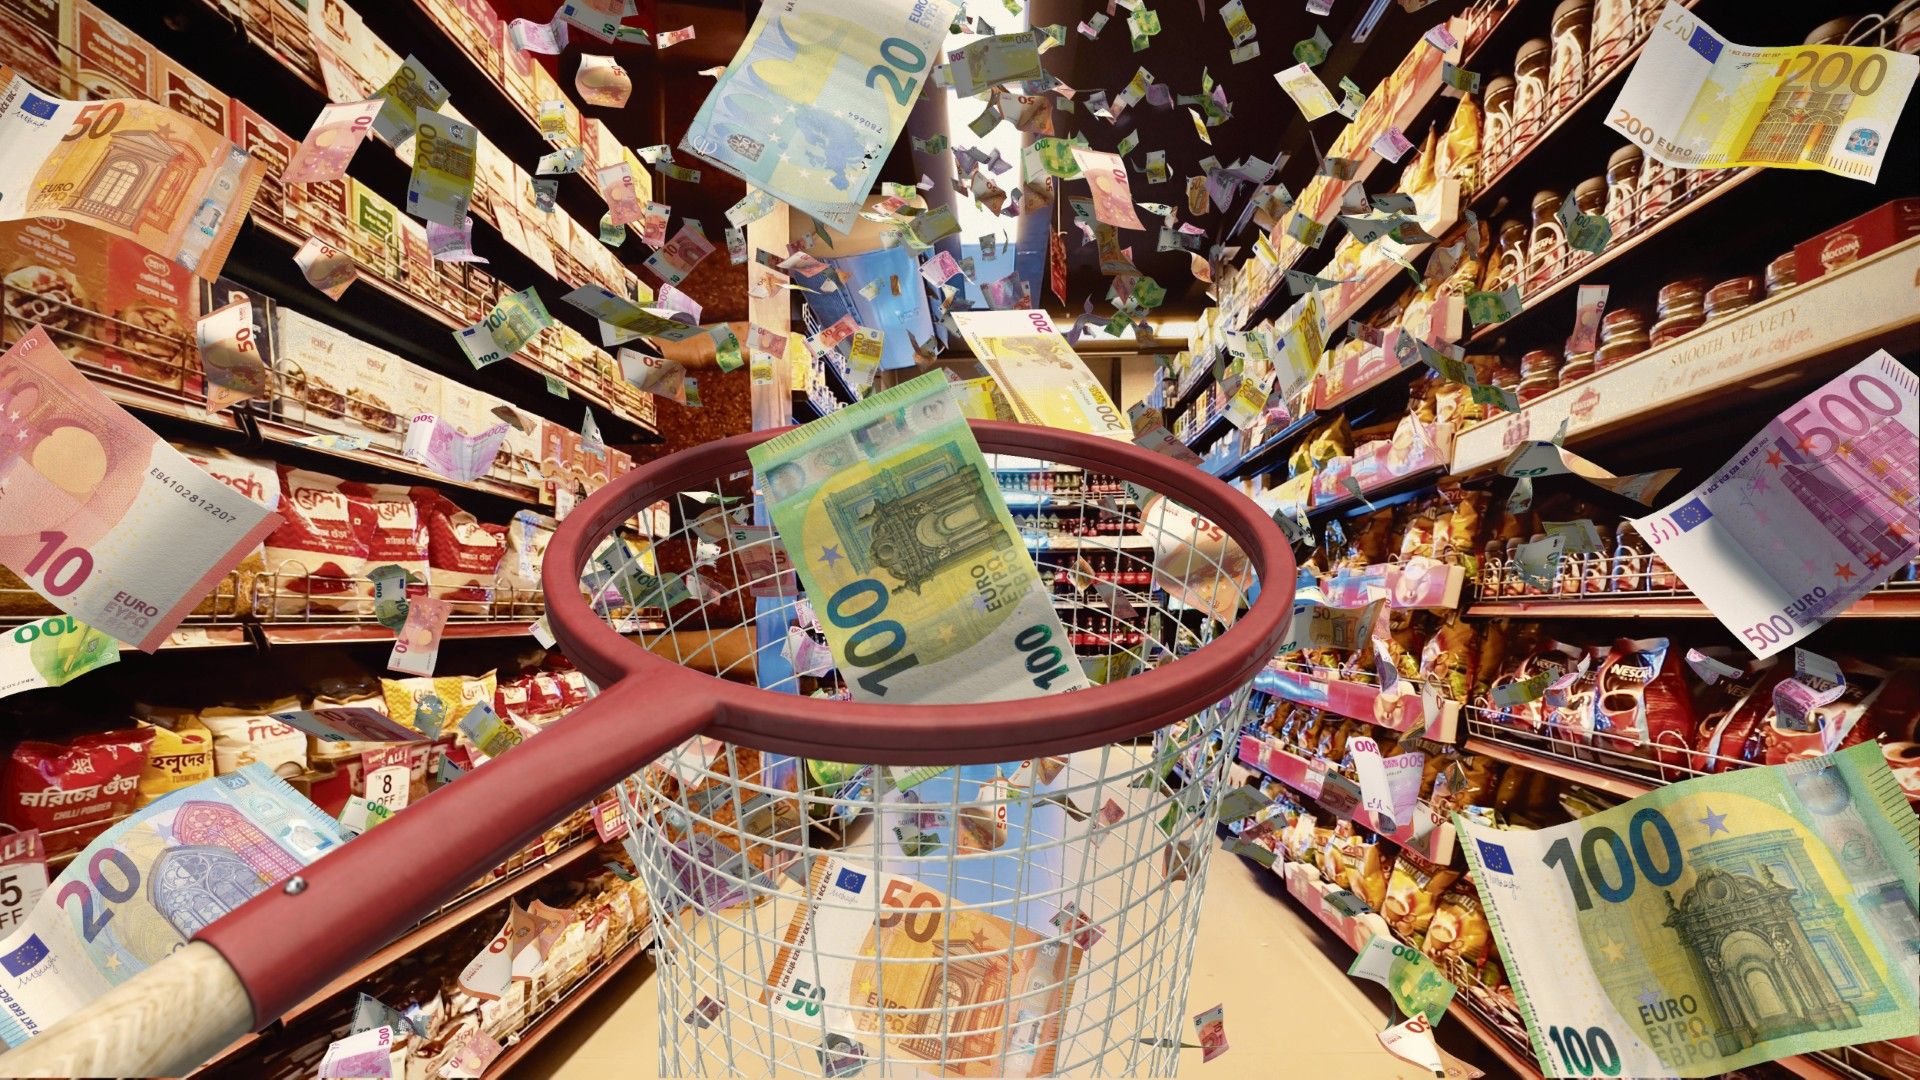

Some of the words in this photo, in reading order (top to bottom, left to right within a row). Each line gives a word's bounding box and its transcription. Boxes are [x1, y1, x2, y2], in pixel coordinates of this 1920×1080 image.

[388, 66, 416, 97] 200
[866, 37, 927, 106] 20
[1787, 50, 1887, 96] 200
[1018, 96, 1035, 105] 50
[62, 102, 126, 141] 50
[351, 116, 372, 133] 10
[1035, 138, 1050, 151] 100
[1613, 110, 1654, 145] 200
[1656, 137, 1692, 157] EURO
[418, 124, 437, 170] 200
[41, 183, 74, 193] EURO
[623, 176, 632, 188] 10
[1113, 169, 1128, 185] 10
[1575, 212, 1591, 229] 100
[320, 245, 336, 258] 50
[665, 244, 678, 257] 10
[483, 307, 508, 333] 100
[1029, 312, 1053, 334] 200
[236, 329, 254, 353] 50
[822, 330, 832, 338] 10
[1669, 336, 1724, 367] SMOOTH
[1731, 307, 1799, 344] VELVETY
[479, 351, 499, 365] 100
[643, 357, 663, 368] 50
[413, 414, 434, 424] 500
[1096, 405, 1125, 430] 200
[1784, 374, 1903, 460] 500
[1514, 467, 1549, 477] 50
[150, 467, 237, 524] EB4102812207
[735, 531, 747, 542] 10
[1191, 516, 1223, 543] 50
[24, 531, 94, 597] 10
[375, 581, 384, 600] 100
[971, 564, 1002, 613] EURO
[113, 591, 159, 618] EURO
[1312, 607, 1331, 620] 50
[14, 615, 78, 643] 100
[1742, 613, 1794, 651] 500
[1784, 585, 1828, 619] EURO
[395, 640, 408, 654] 10
[827, 578, 919, 696] 100
[1014, 624, 1069, 690] 100
[314, 710, 346, 722] 10
[498, 726, 523, 746] 200
[381, 749, 409, 768] SALE!
[1355, 740, 1381, 756] 500
[152, 752, 206, 775] হলুদের
[1399, 753, 1424, 769] 500
[20, 784, 102, 808] মরিচের
[103, 773, 141, 796] গুঁড়া
[383, 774, 392, 795] 8
[53, 808, 81, 821] CHILLI
[81, 801, 112, 815] POWDER
[367, 801, 388, 819] 100
[1543, 807, 1684, 911] 100
[57, 848, 140, 943] 20
[0, 908, 24, 930] FF
[873, 880, 942, 943] 50
[490, 922, 514, 954] 50
[1392, 944, 1420, 966] 100
[786, 979, 826, 1017] 50
[1638, 994, 1698, 1026] EURO
[1405, 1015, 1431, 1034] 50
[378, 1028, 391, 1047] 500
[1549, 1025, 1622, 1077] 100
